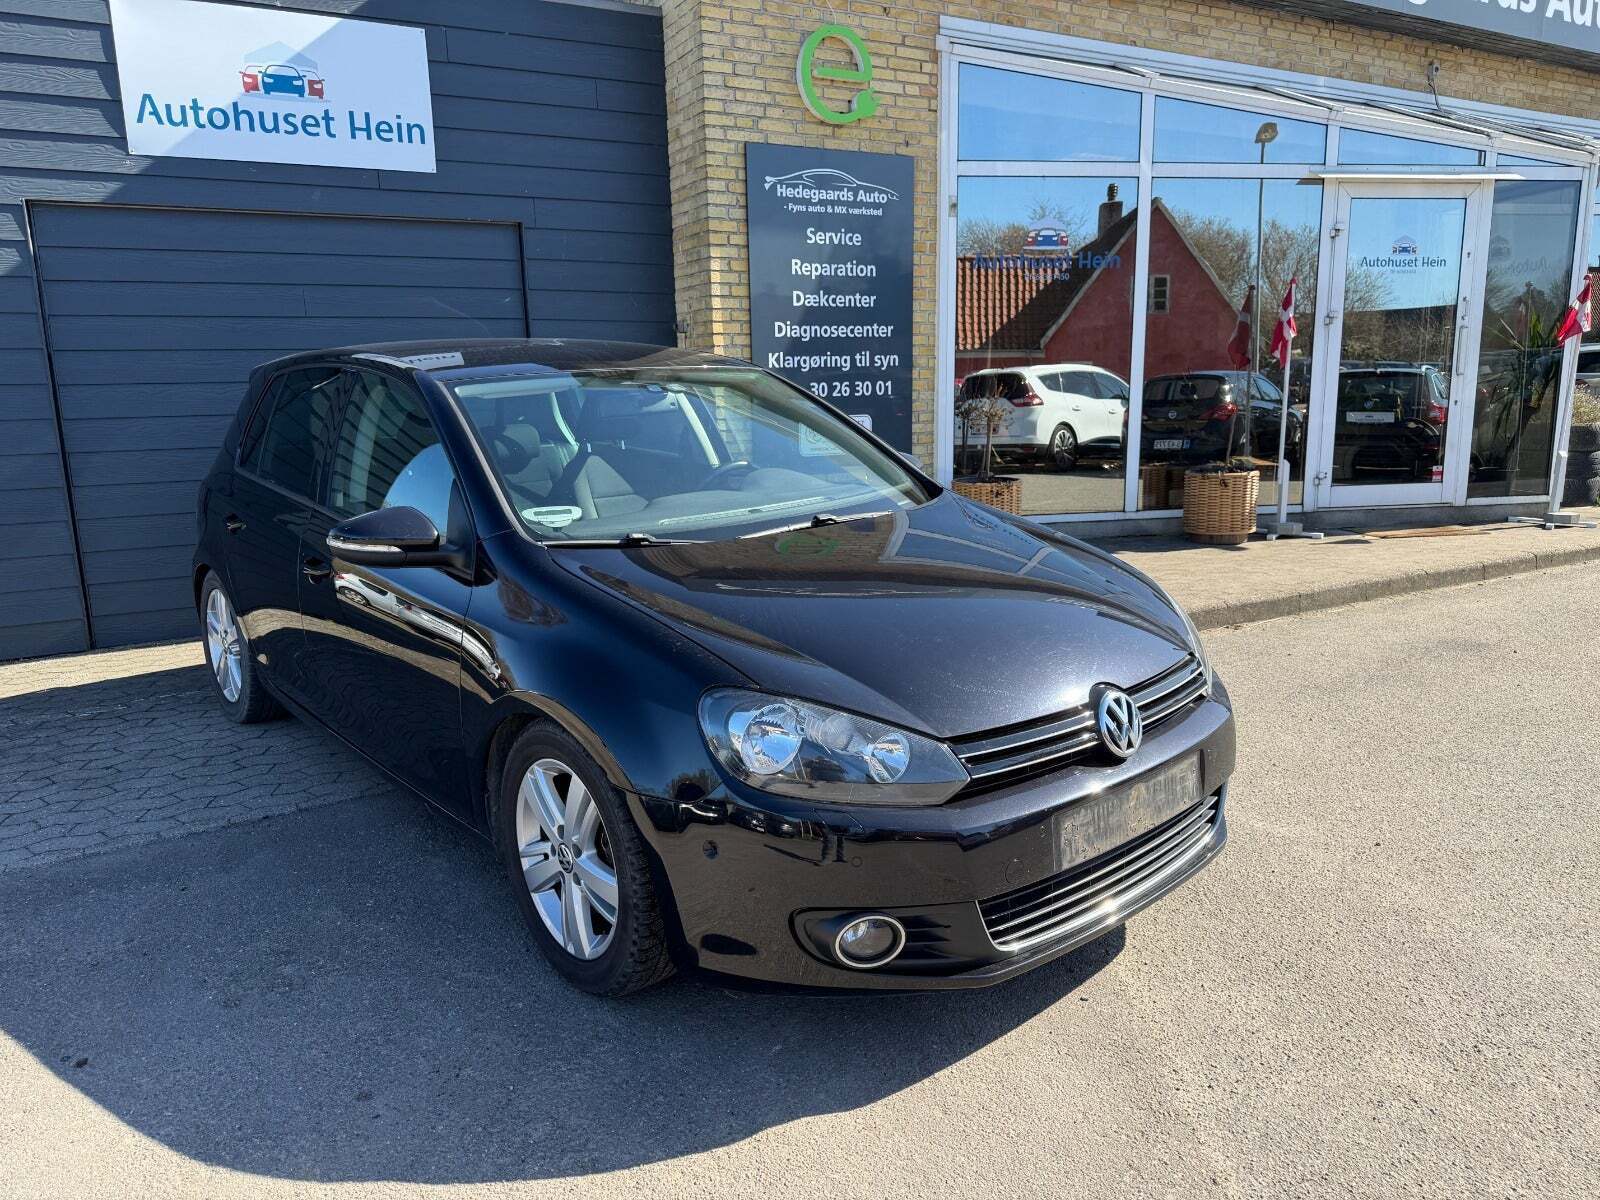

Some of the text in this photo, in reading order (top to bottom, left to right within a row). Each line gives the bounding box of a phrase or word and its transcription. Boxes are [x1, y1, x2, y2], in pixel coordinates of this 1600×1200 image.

[136, 93, 426, 145] Autohuset Hein
[776, 184, 888, 203] Hedegaards Auto
[788, 203, 806, 213] Fyns
[808, 205, 826, 213] auto
[826, 205, 833, 213] &
[834, 206, 847, 214] MX
[848, 207, 882, 216] værksted
[806, 227, 862, 246] Service
[791, 258, 877, 280] Reparation
[1078, 250, 1121, 269] Hein
[1360, 255, 1447, 268] Autohuset Hein
[792, 290, 877, 308] Dækcenter
[774, 321, 894, 341] Diagnosecenter
[768, 351, 899, 372] Klargøring til syn
[810, 380, 893, 398] 30 26 30 01
